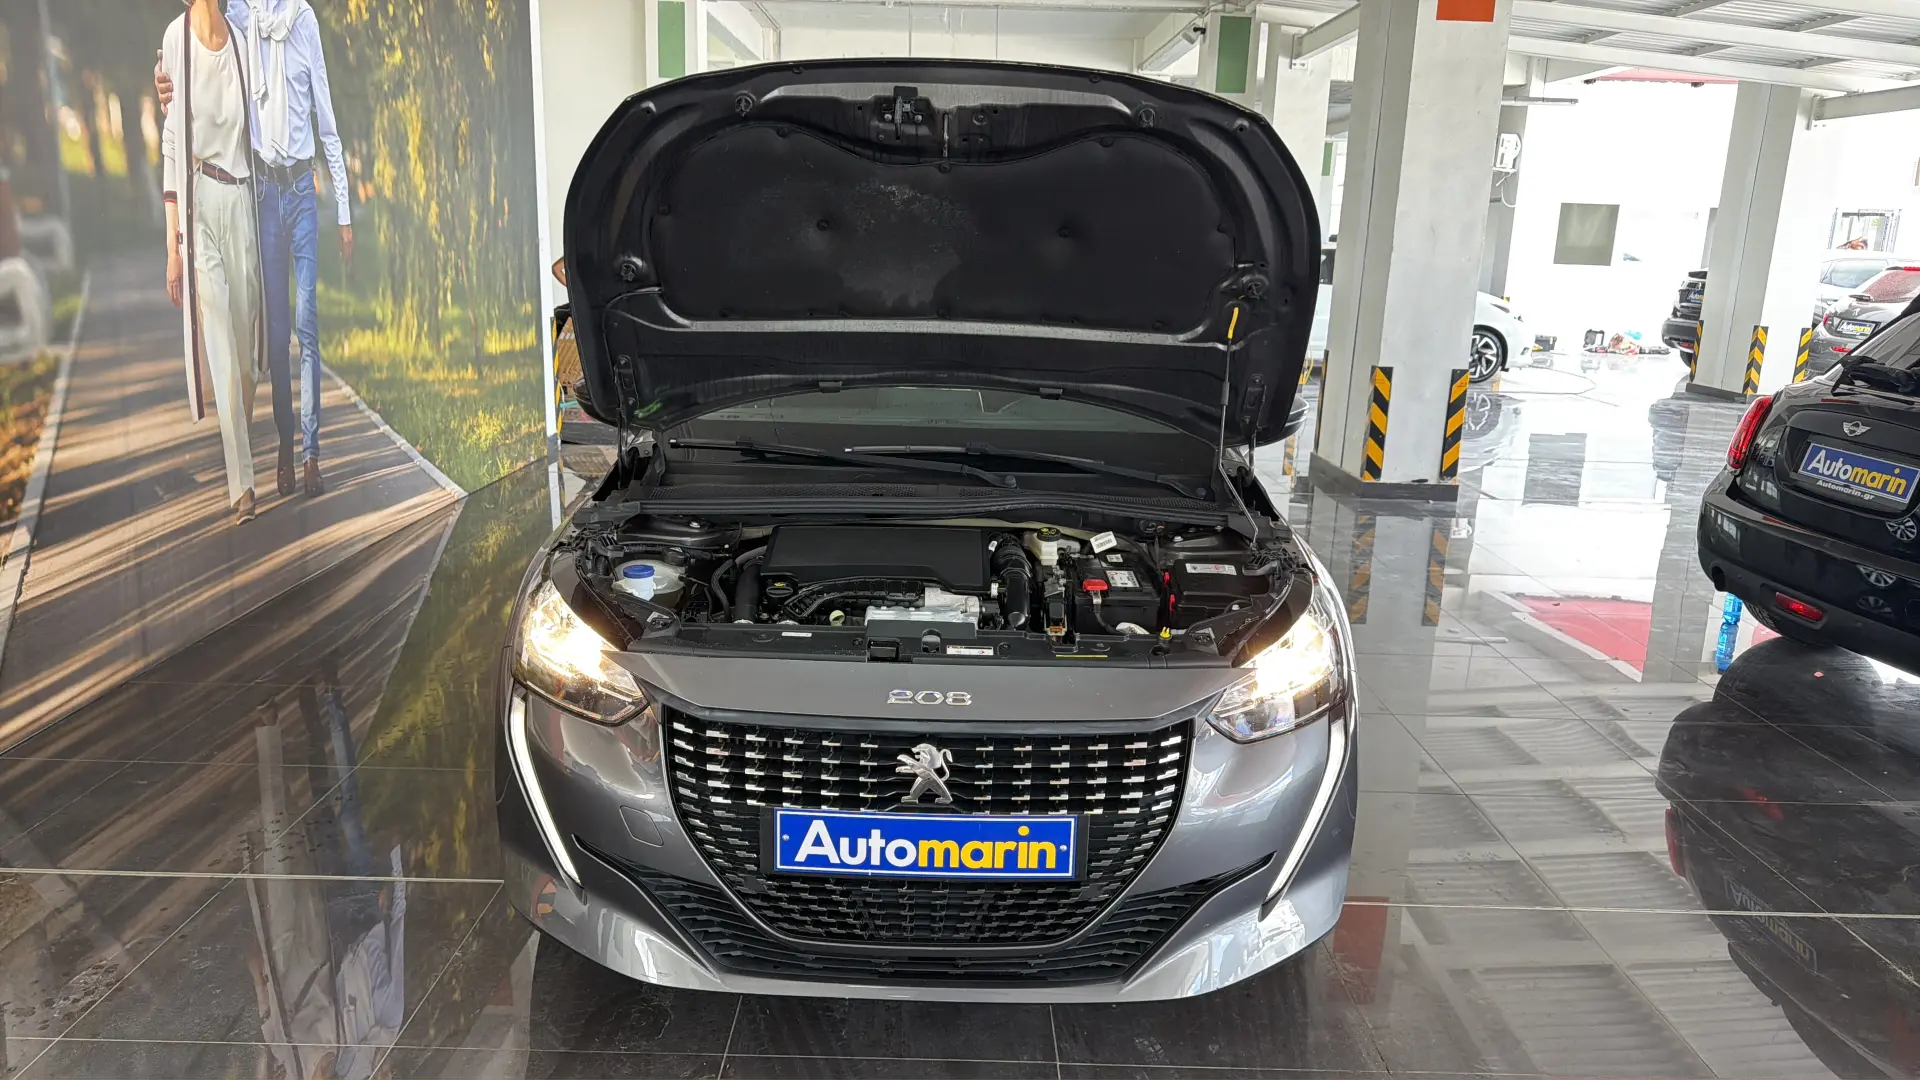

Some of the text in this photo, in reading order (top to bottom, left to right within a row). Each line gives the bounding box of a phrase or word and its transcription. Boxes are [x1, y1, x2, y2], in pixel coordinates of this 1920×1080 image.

[1807, 449, 1907, 495] Automarin
[1816, 480, 1875, 500] Automarin.gr
[887, 689, 972, 705] 208
[794, 819, 1056, 869] Automarin
